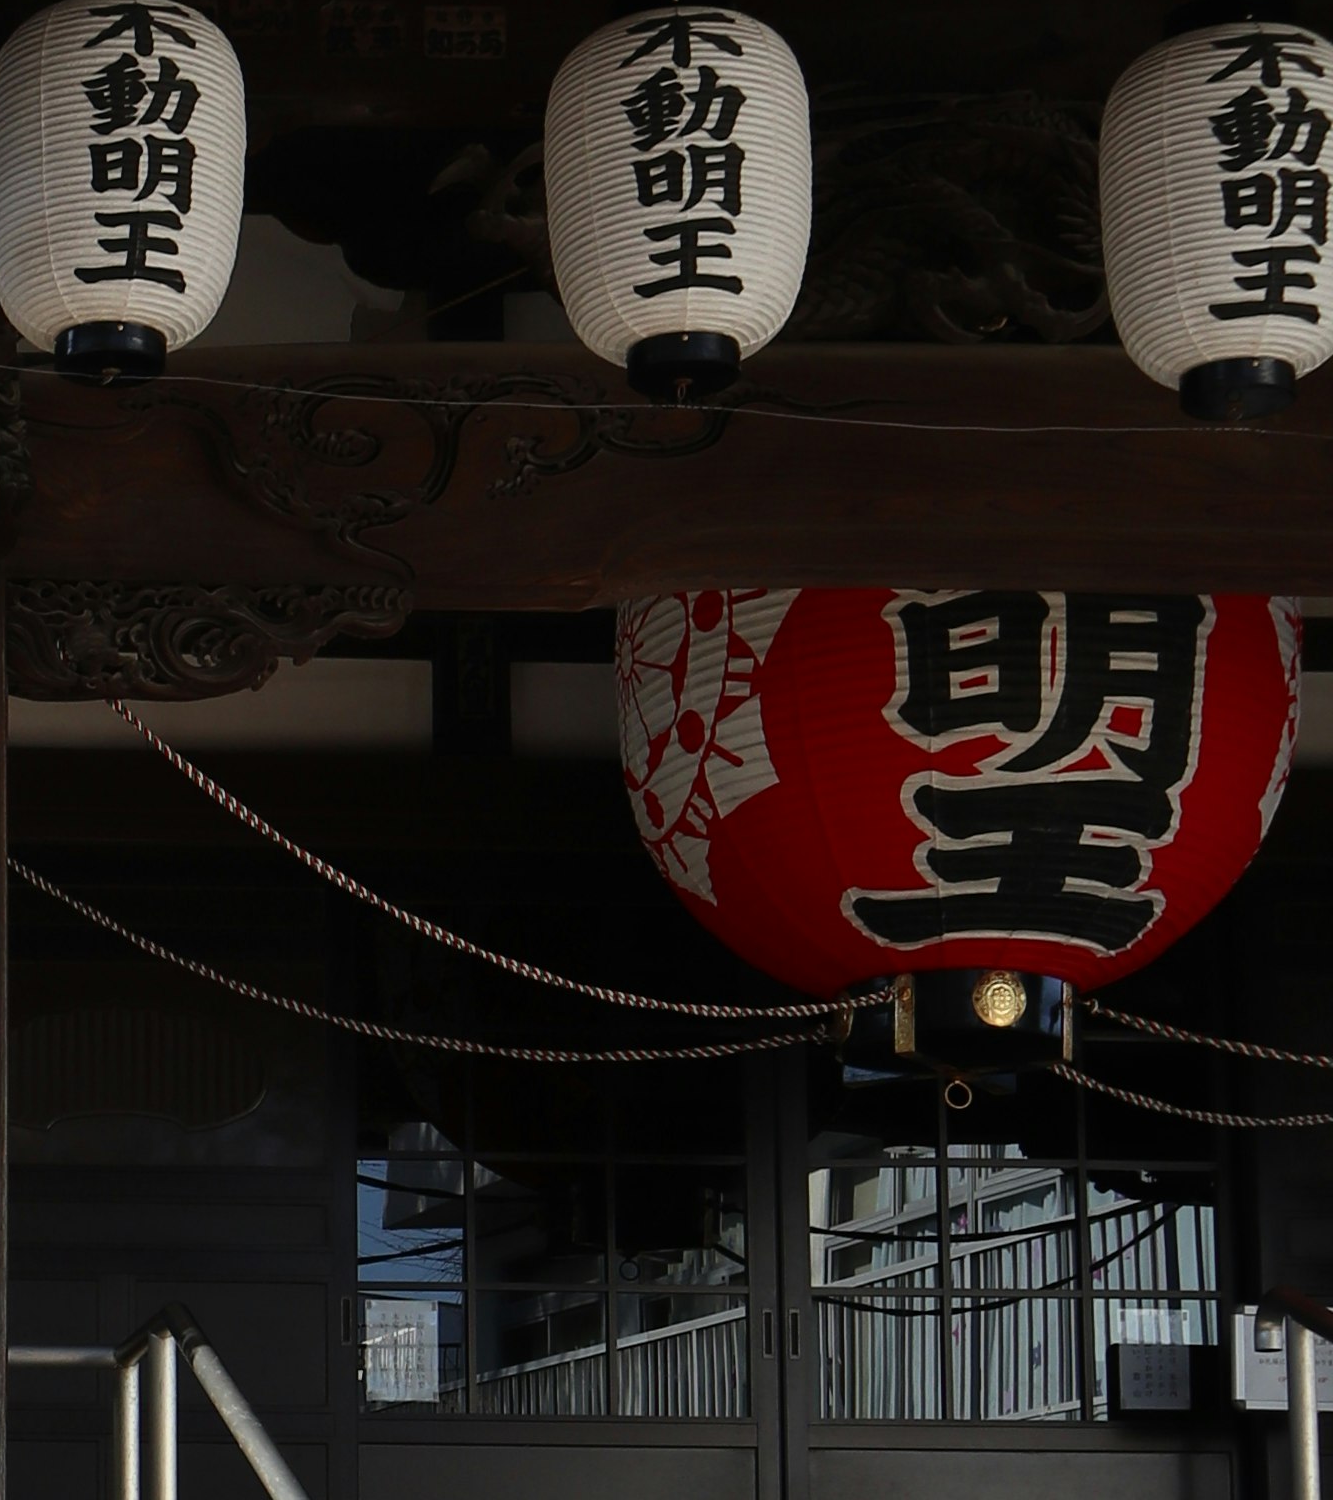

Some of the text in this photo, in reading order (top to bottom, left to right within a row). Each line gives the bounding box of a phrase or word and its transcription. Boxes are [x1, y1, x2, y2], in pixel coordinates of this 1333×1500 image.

[74, 2, 201, 294] 不動明王
[622, 13, 747, 298] 不動明王
[1205, 31, 1332, 325] 不動明王
[840, 591, 1216, 956] 明王
